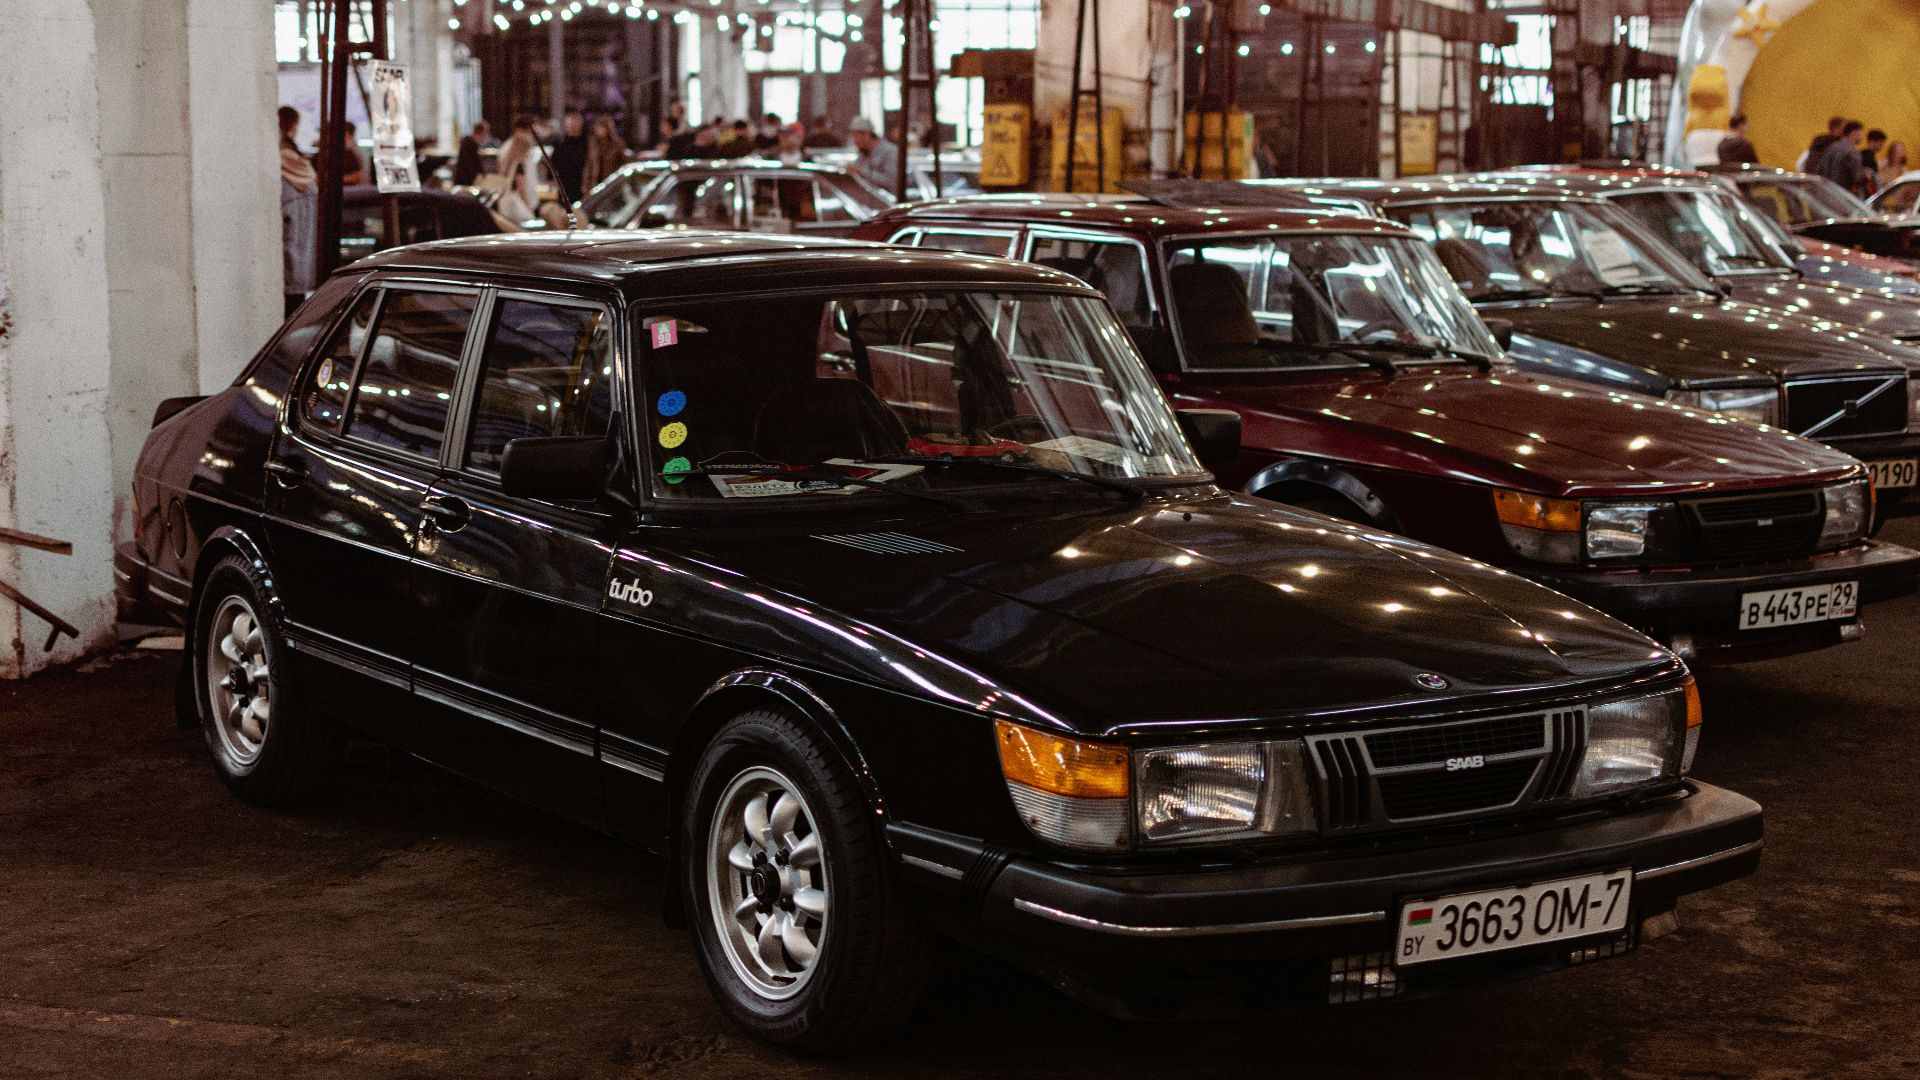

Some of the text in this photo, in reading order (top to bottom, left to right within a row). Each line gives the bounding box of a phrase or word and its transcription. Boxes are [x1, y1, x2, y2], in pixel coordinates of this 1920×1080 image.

[609, 577, 654, 607] turbo
[1832, 583, 1853, 607] 29
[1446, 755, 1485, 771] SAAB
[1436, 877, 1626, 951] 3663 OM-7
[1402, 935, 1425, 957] BY
